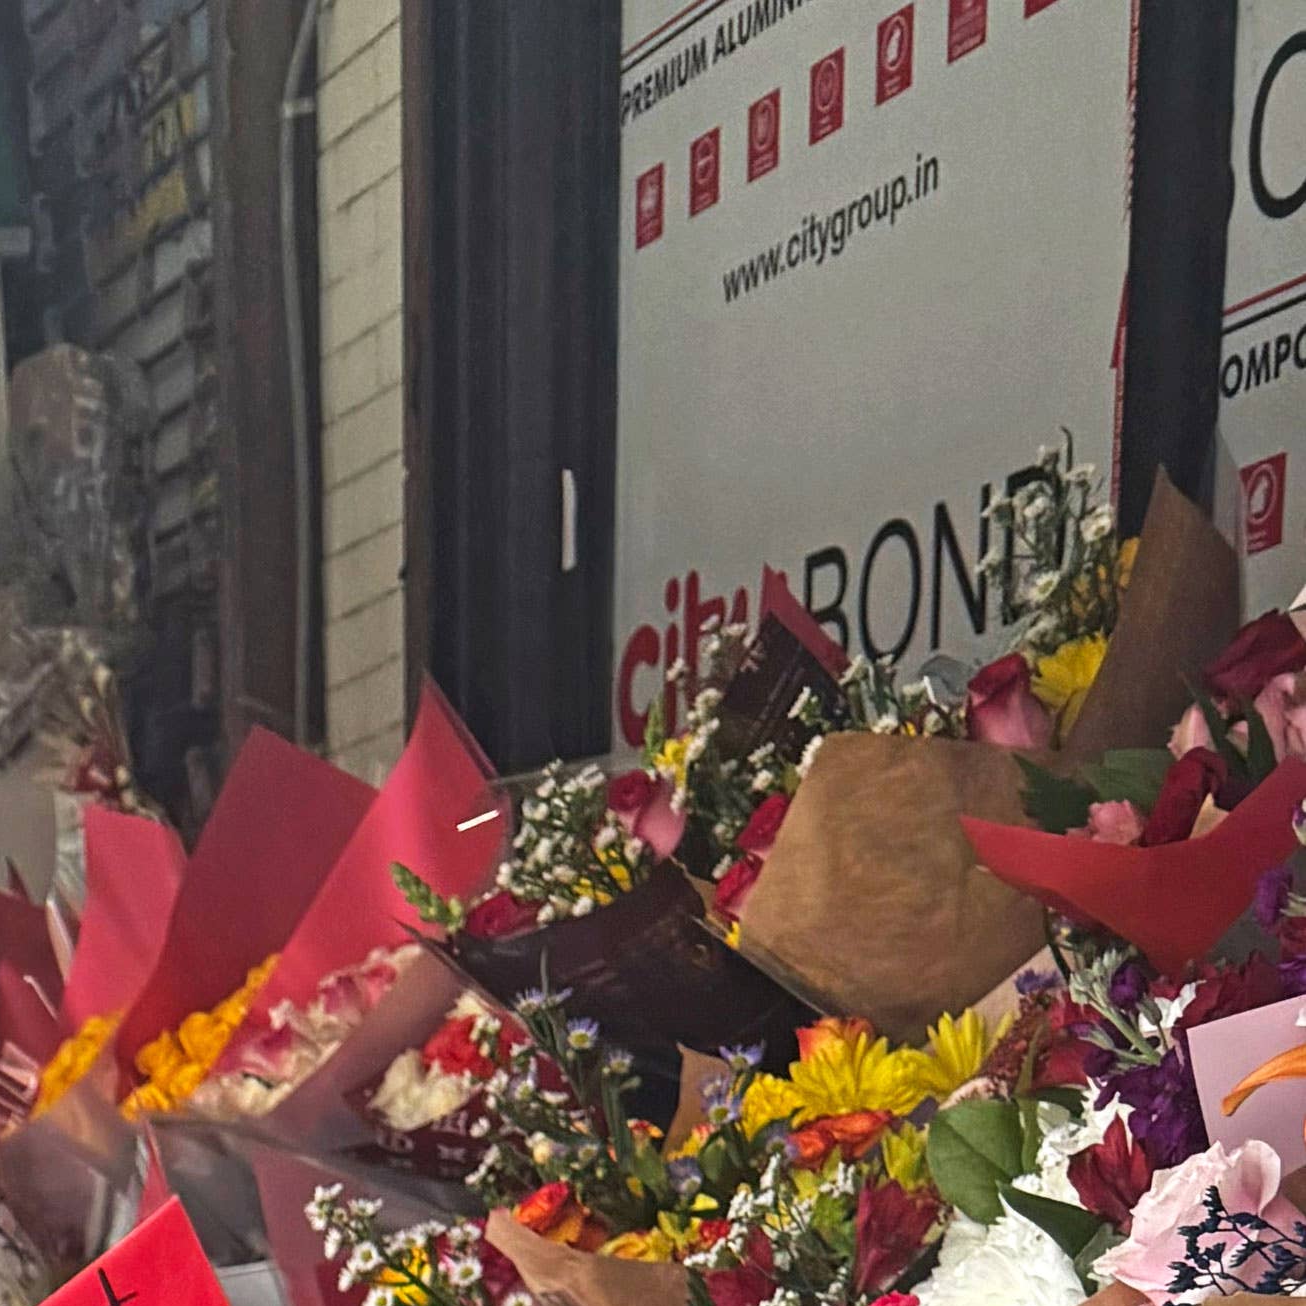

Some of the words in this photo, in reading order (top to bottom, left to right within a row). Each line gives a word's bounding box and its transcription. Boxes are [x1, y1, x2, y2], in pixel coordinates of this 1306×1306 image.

[621, 37, 707, 126] PREMIUM
[712, 0, 805, 65] ALUMI
[723, 153, 939, 303] www.citygroup.in
